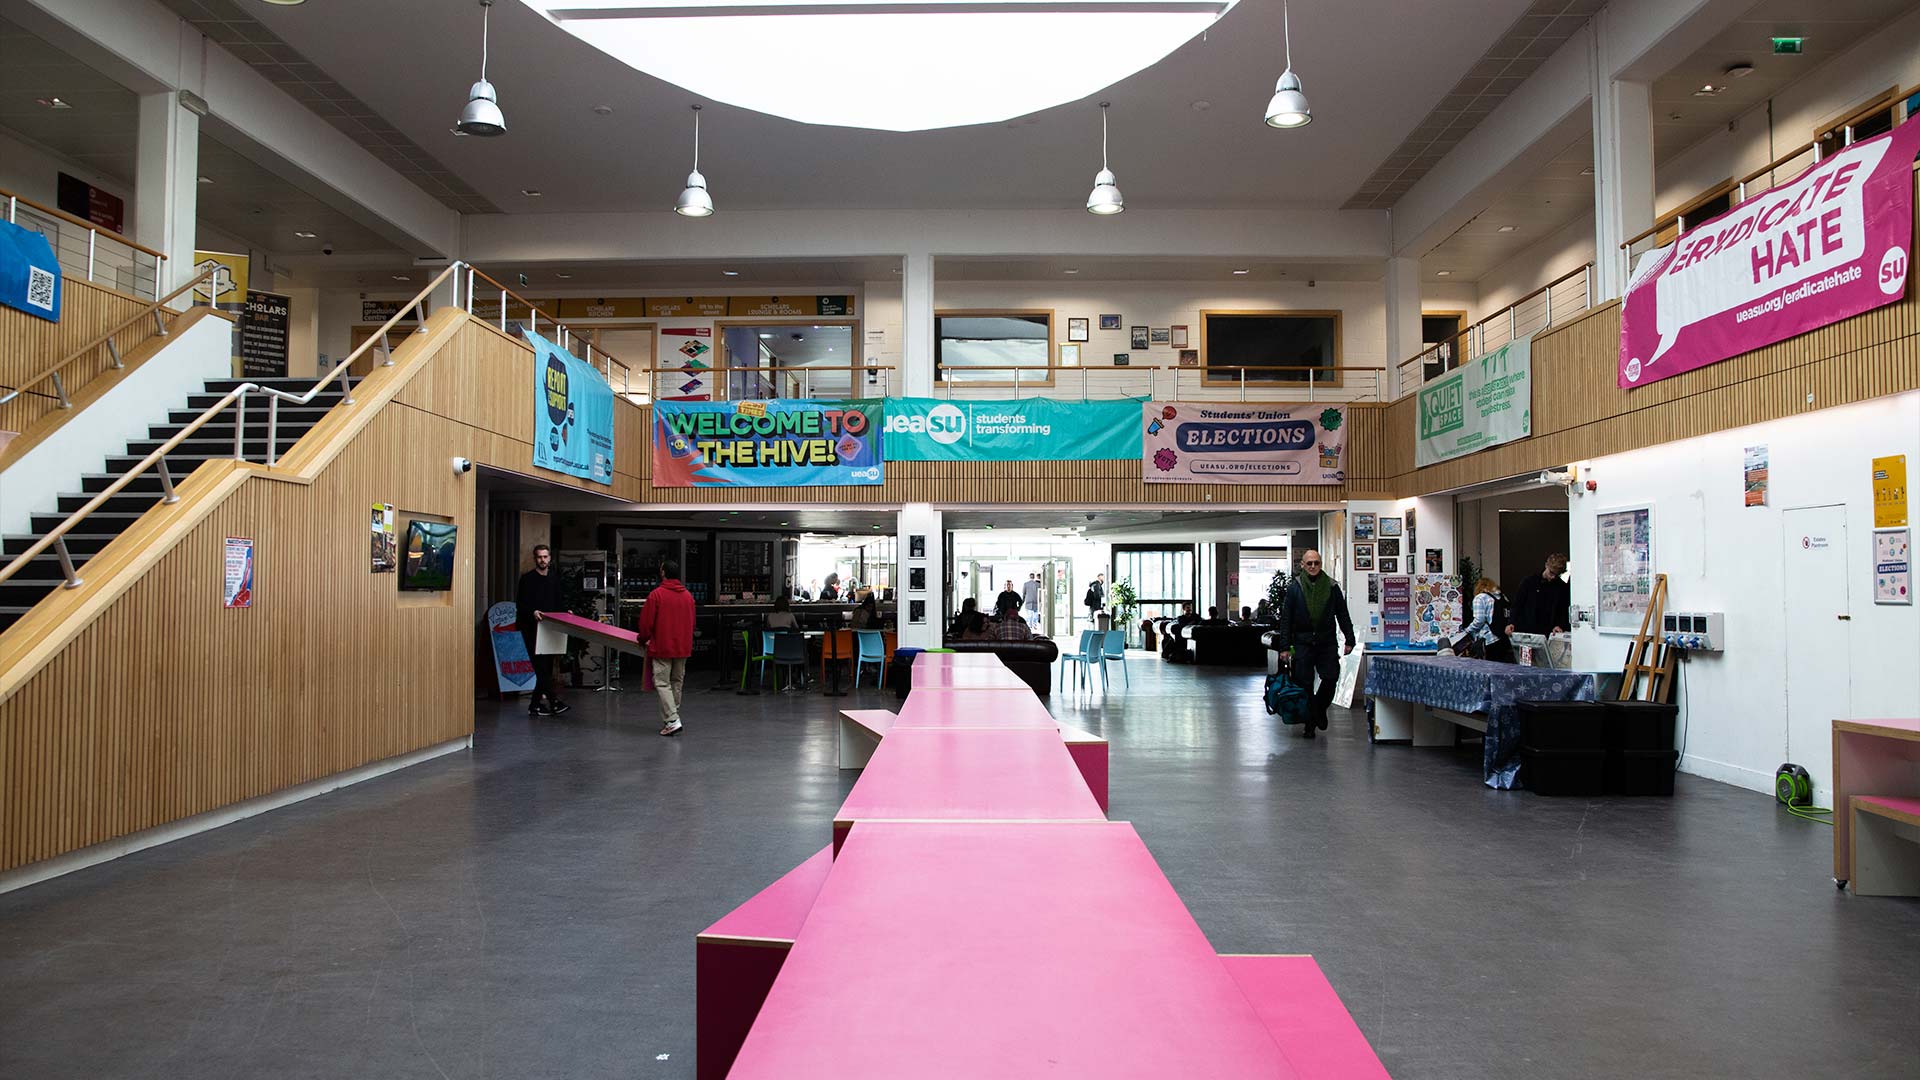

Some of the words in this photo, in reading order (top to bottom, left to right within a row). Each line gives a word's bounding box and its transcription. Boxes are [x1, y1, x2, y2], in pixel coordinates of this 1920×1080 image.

[1751, 207, 1843, 285] HATE
[1736, 266, 1862, 324] ueasu.org/eradicatehate
[1430, 384, 1462, 418] QUIET
[667, 411, 819, 436] WELCOME
[825, 410, 866, 433] TO
[976, 413, 1026, 424] students
[1257, 410, 1291, 420] Union
[1439, 408, 1462, 425] SPACE
[976, 423, 1051, 436] transforming
[1186, 427, 1306, 446] ELECTIONS
[697, 441, 754, 464] THE
[760, 440, 836, 463] HIVE!
[1200, 463, 1291, 471] UEASU.ORG/ELECTIONS
